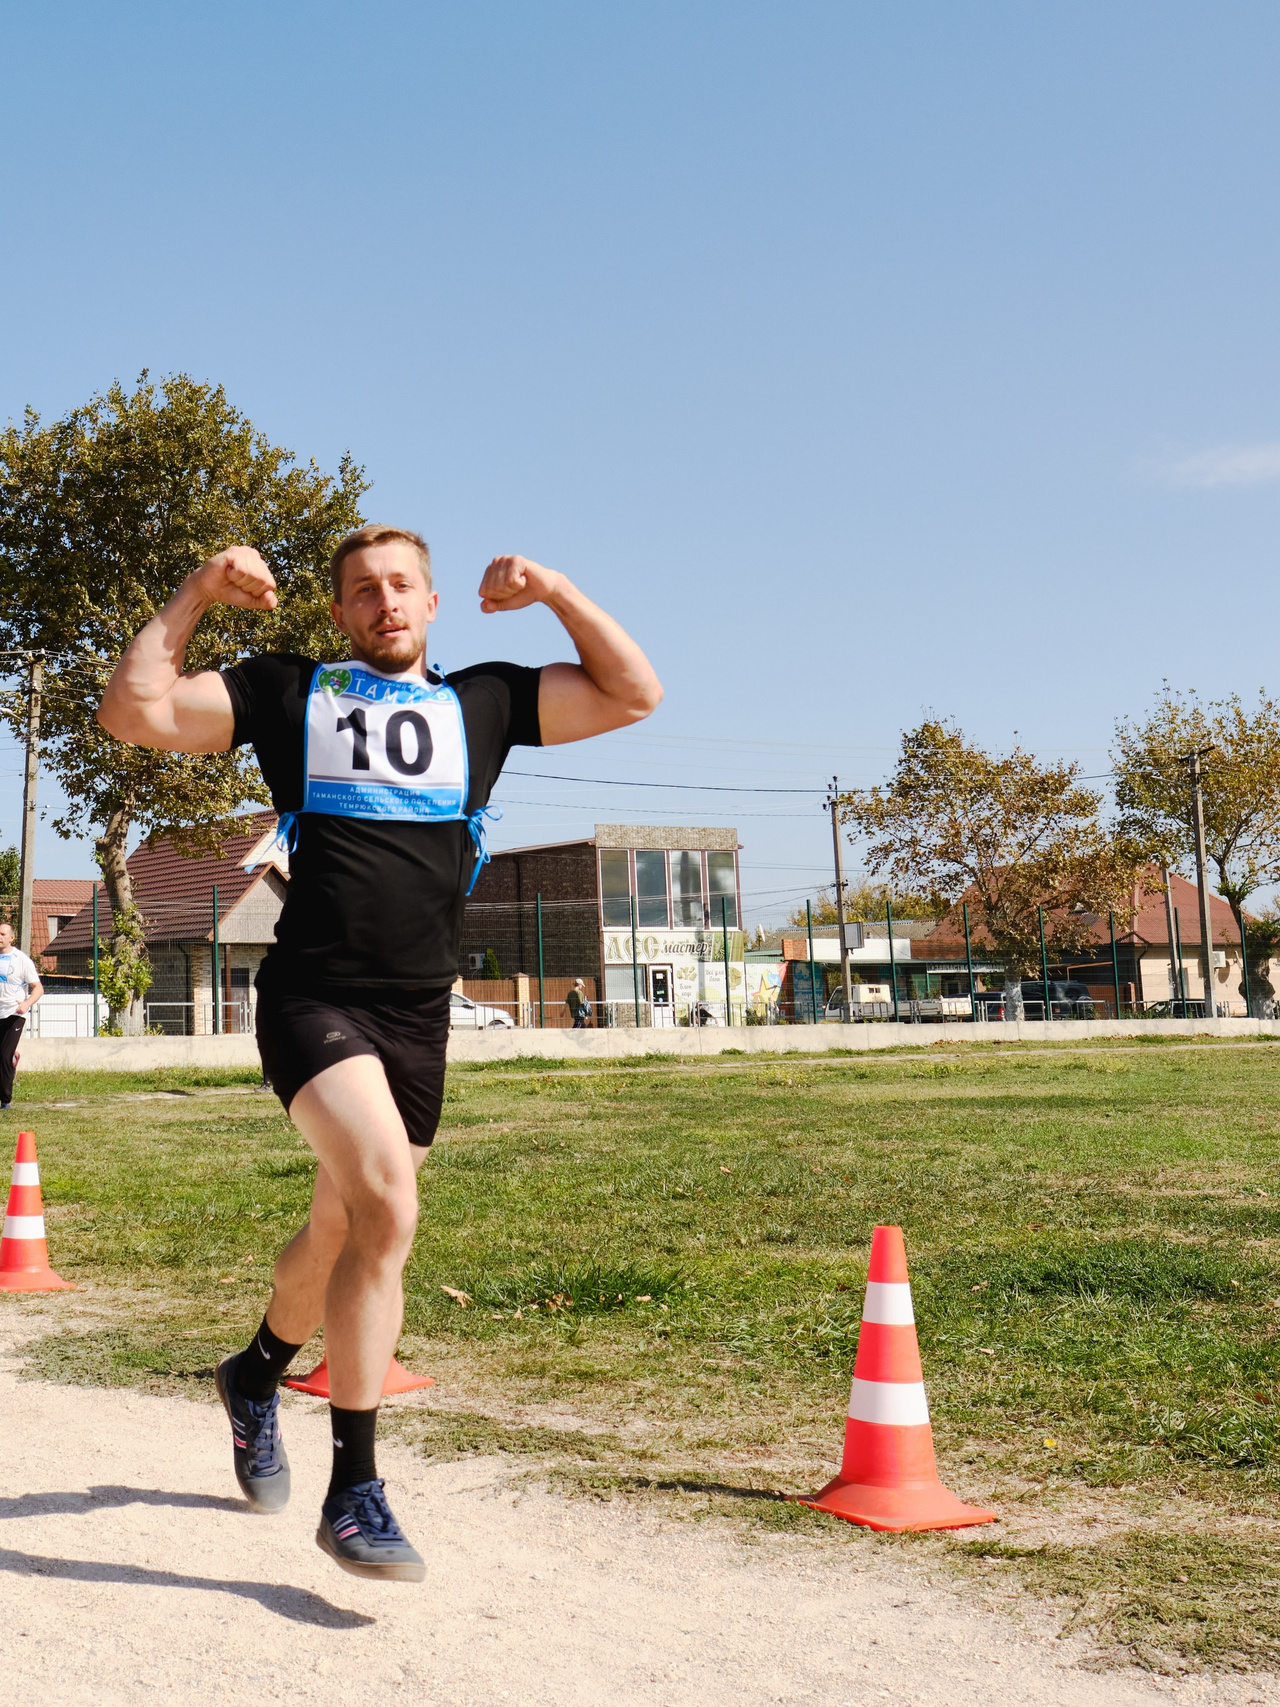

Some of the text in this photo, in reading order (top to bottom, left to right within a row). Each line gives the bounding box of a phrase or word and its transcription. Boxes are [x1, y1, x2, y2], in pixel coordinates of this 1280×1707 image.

[355, 677, 448, 704] ТАМАЬ
[336, 707, 434, 776] 10
[312, 792, 362, 802] ТАМАНСКОГО
[363, 795, 409, 805] СЕЛЬСКОГО
[349, 786, 421, 797] АДМИНИСТРАЦИЯ
[661, 942, 708, 956] мастер
